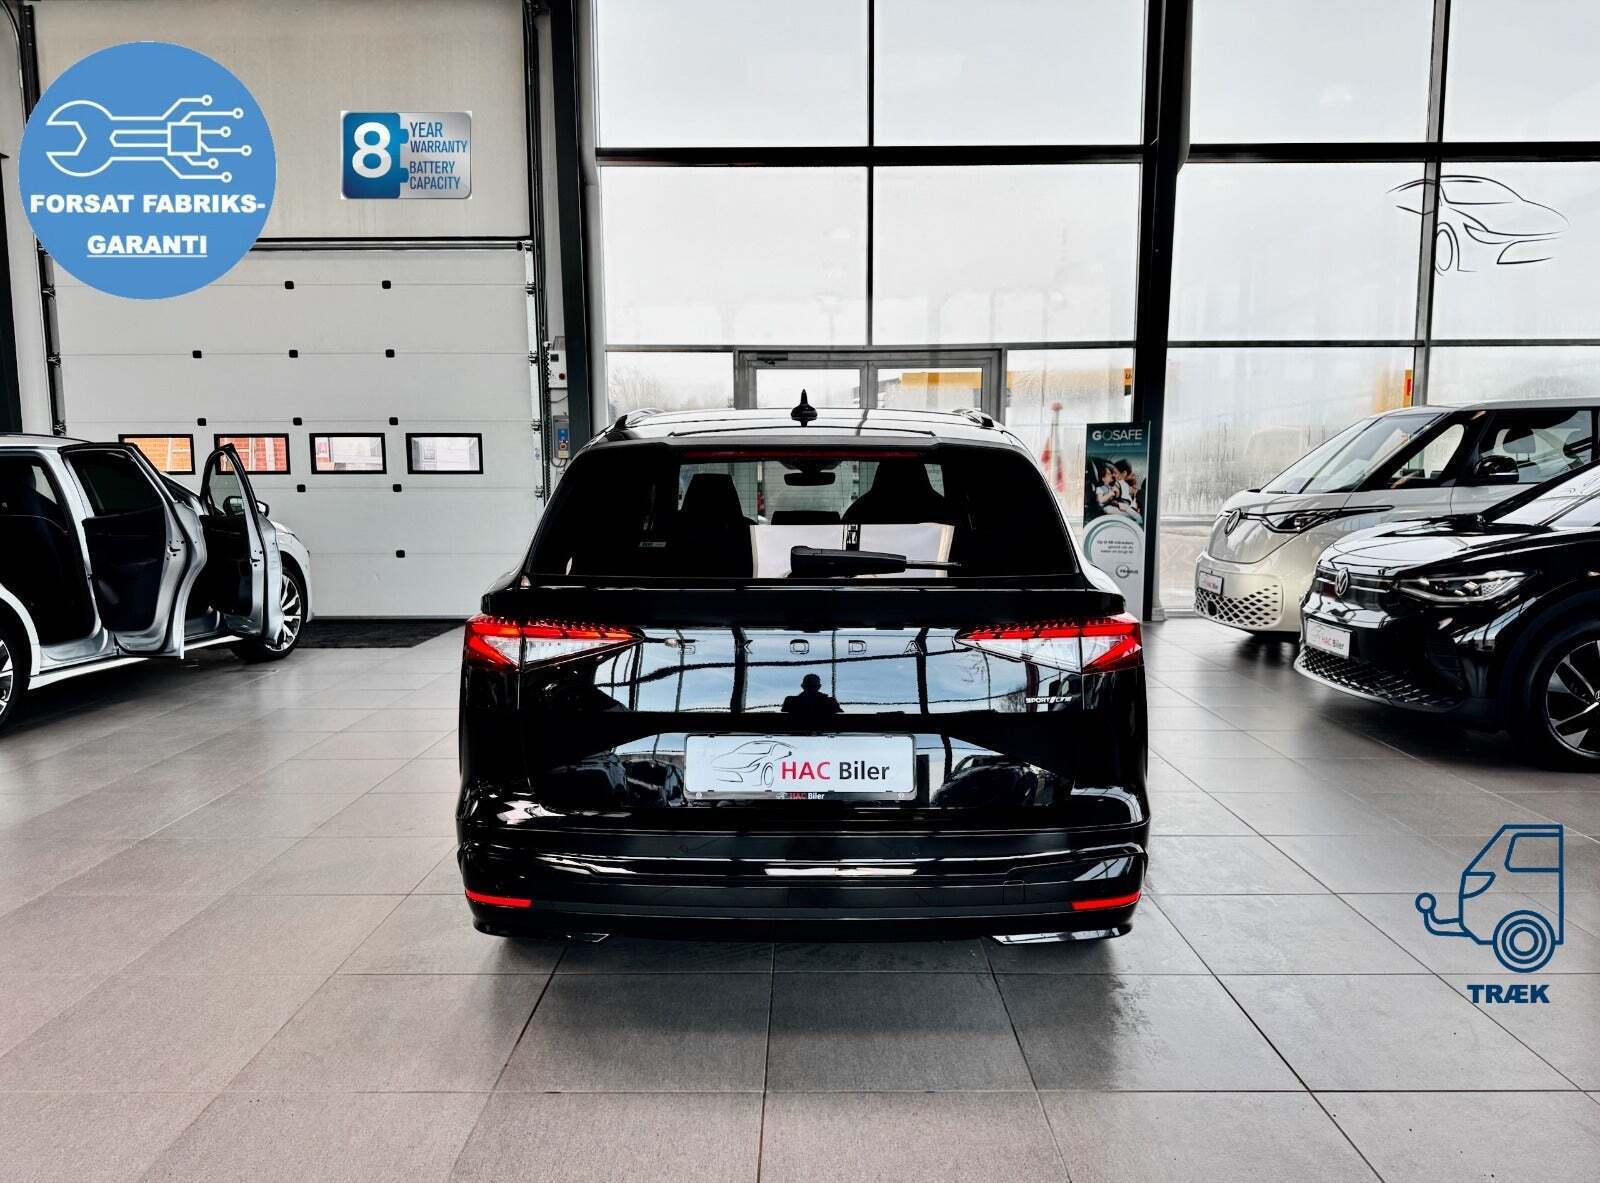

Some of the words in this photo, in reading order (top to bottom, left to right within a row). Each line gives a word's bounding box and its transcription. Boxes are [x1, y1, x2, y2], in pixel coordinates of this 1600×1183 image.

[1092, 429, 1143, 441] GOSAFE
[781, 761, 831, 780] HAC
[839, 760, 890, 780] Biler
[807, 791, 824, 800] Biler
